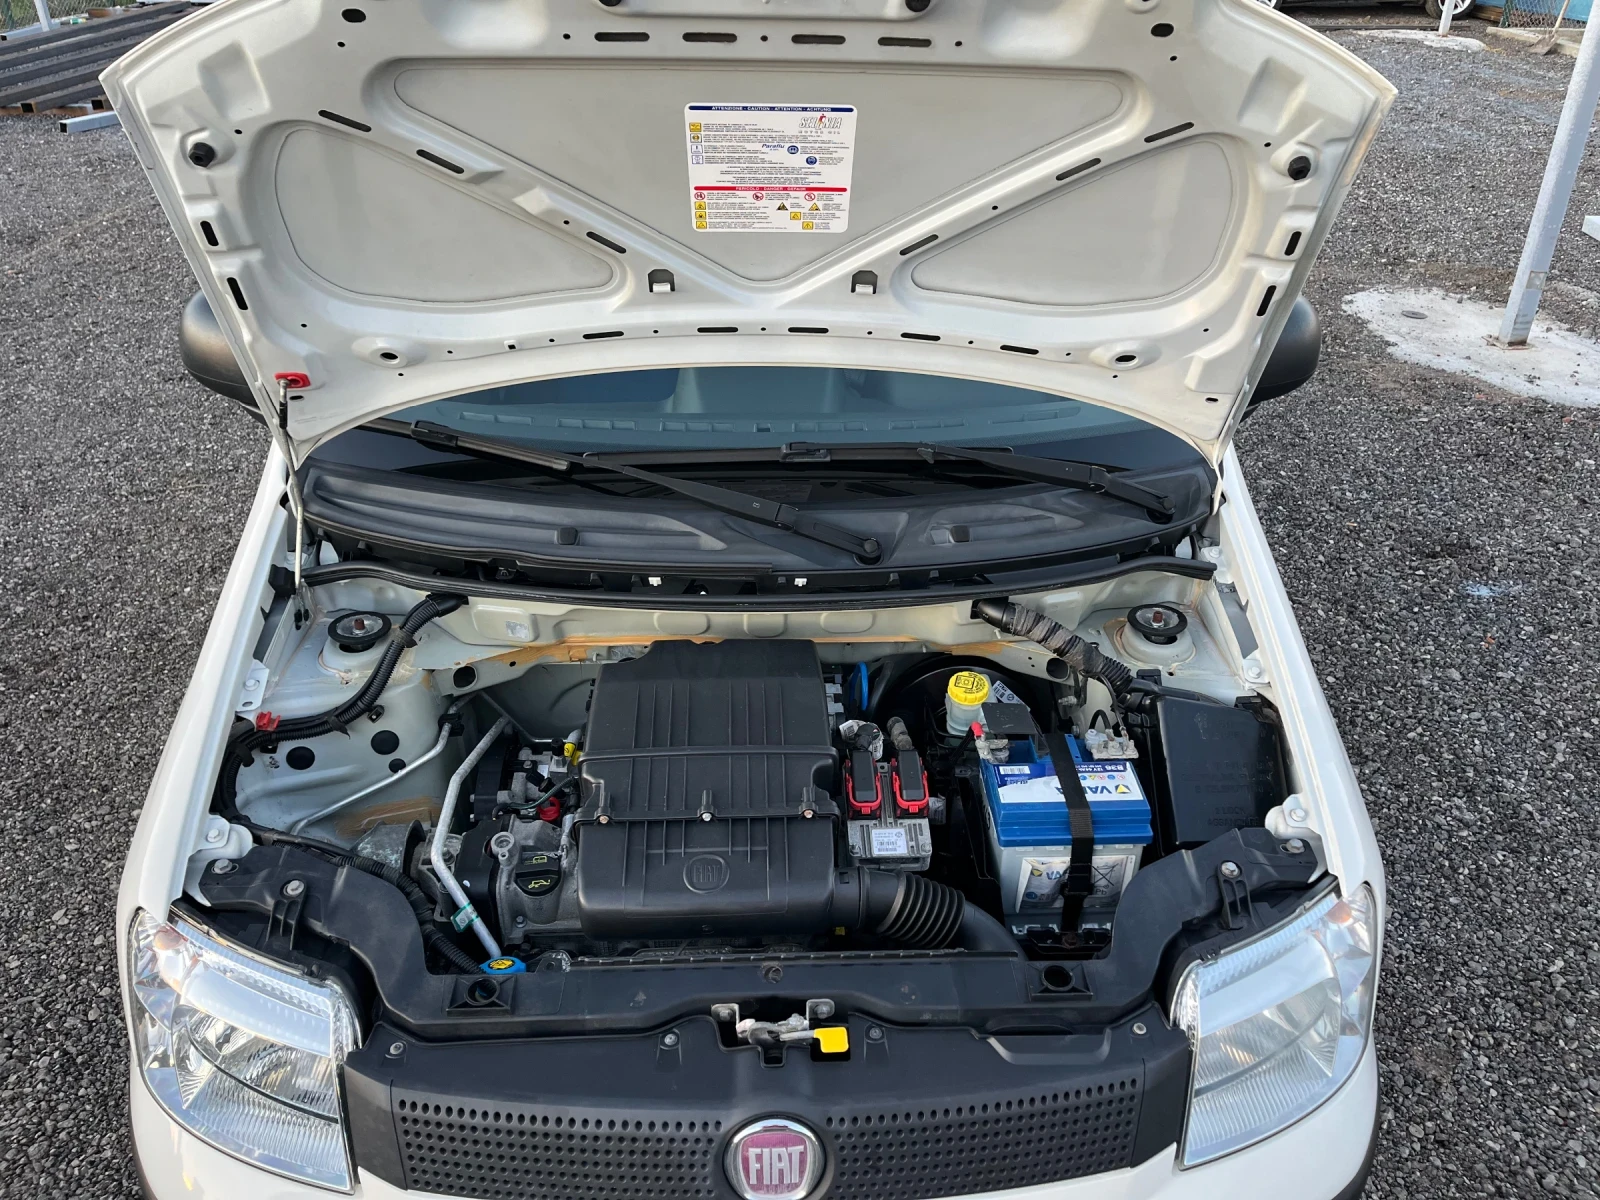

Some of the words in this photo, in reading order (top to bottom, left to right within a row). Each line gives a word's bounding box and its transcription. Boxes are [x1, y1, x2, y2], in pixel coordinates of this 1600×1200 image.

[1054, 785, 1113, 795] VAA
[1095, 888, 1108, 896] Pb
[748, 1145, 805, 1185] FIAT
